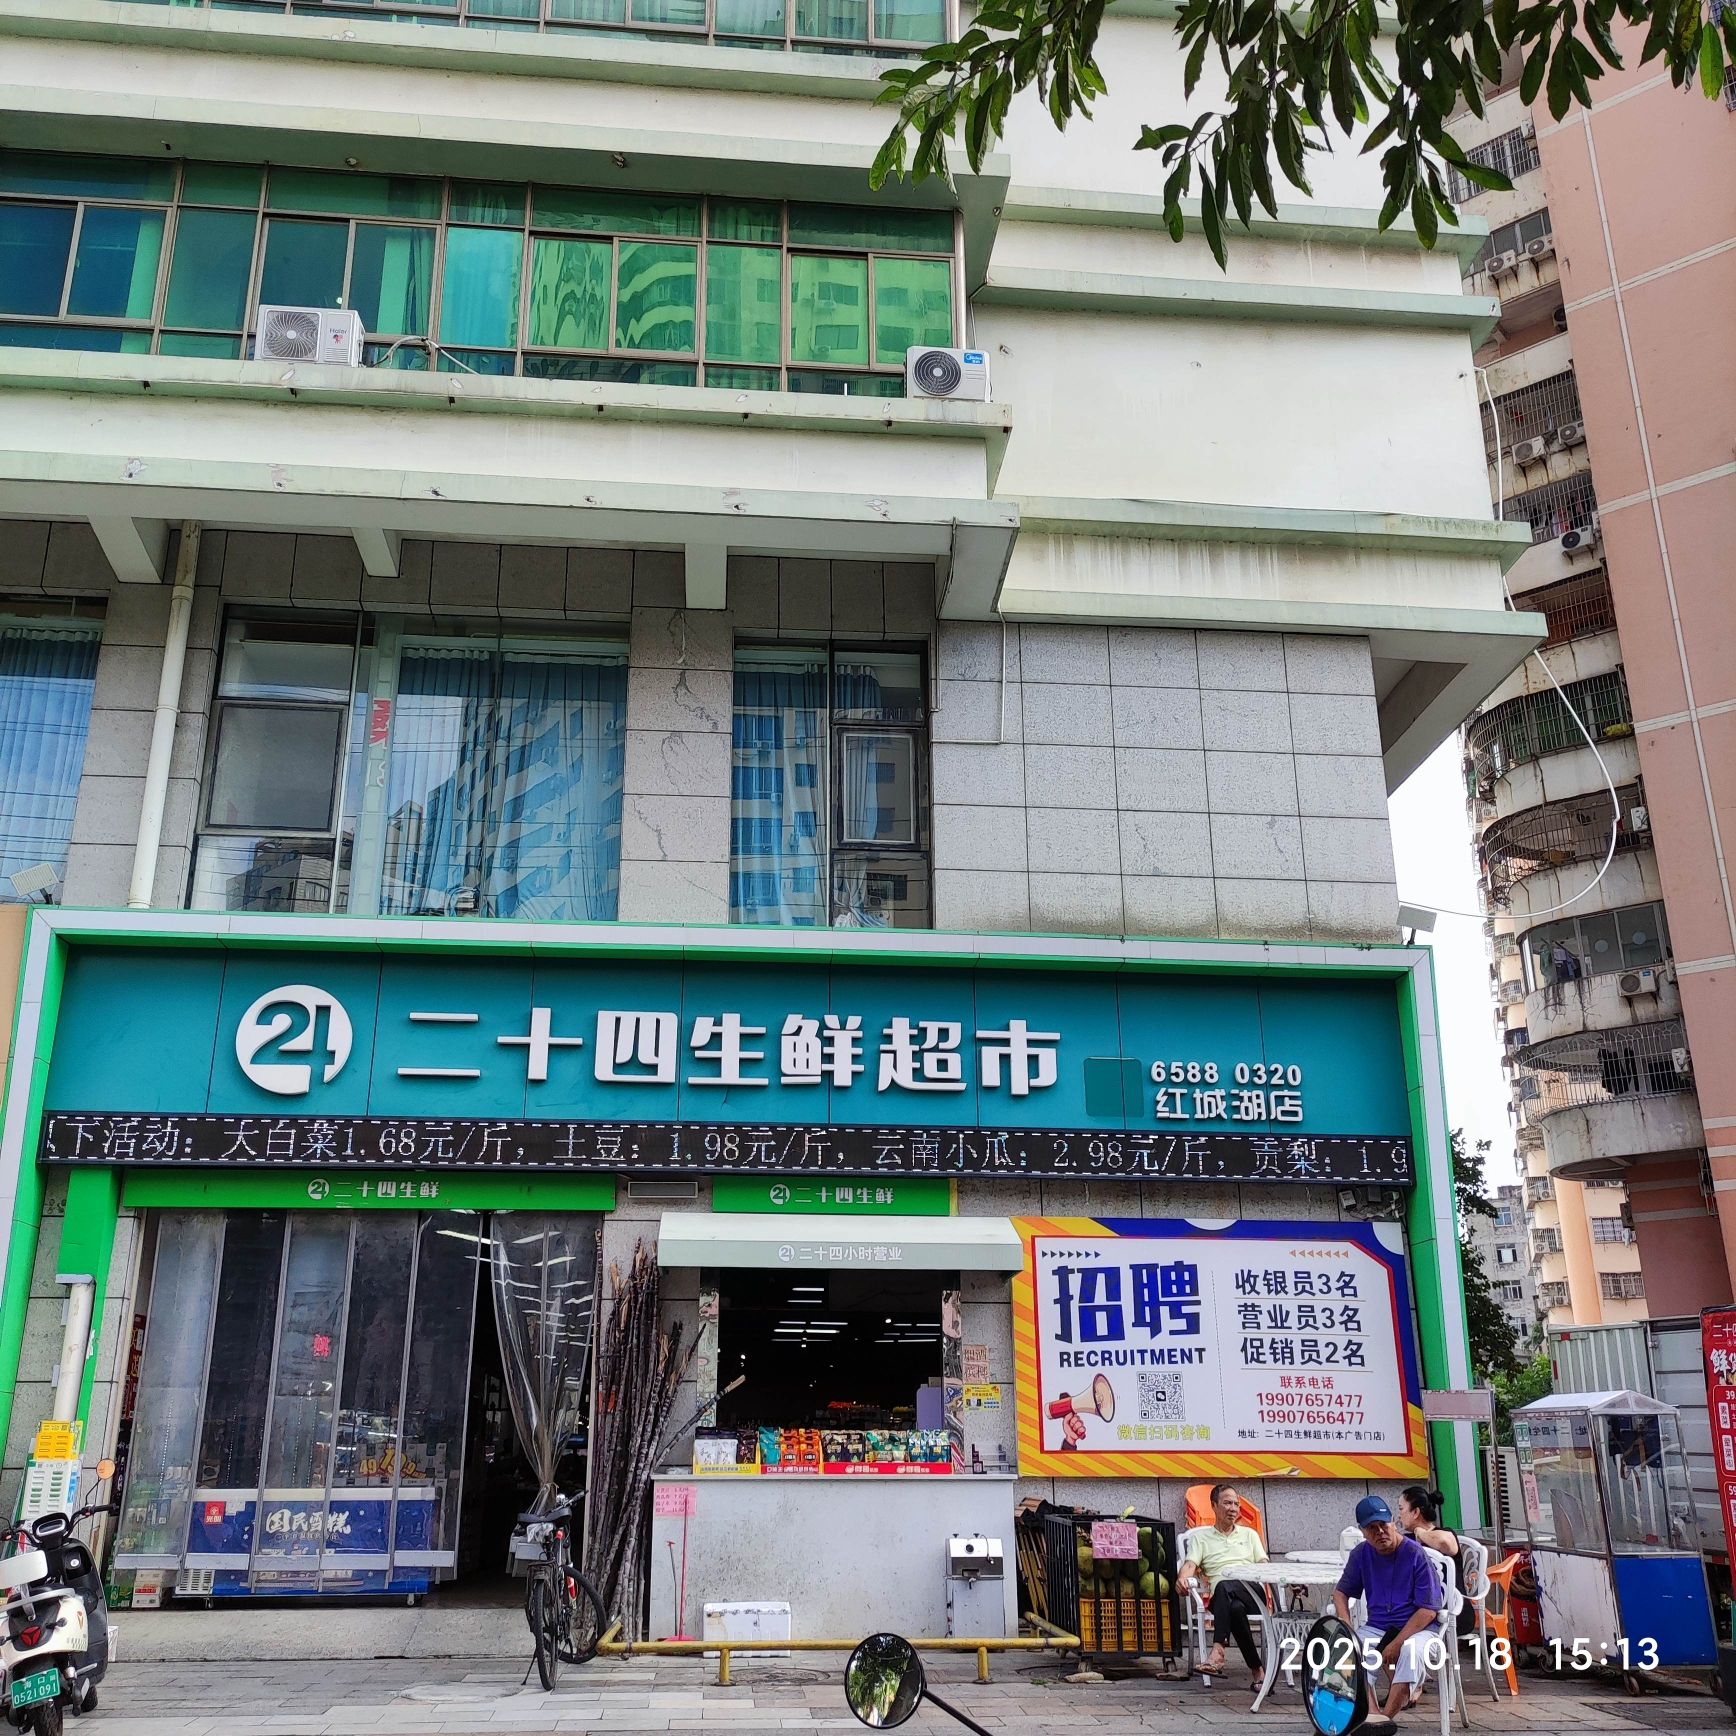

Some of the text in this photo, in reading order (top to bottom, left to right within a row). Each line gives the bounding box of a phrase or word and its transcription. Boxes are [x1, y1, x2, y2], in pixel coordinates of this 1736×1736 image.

[397, 1005, 1062, 1096] 二十四生鲜超市
[1150, 1060, 1303, 1087] 6588 0320
[1154, 1086, 1304, 1123] 红城湖店
[333, 1180, 440, 1199] 二十四生鲜
[794, 1185, 895, 1205] 二十四生鲜
[799, 1245, 903, 1262] 二十四小时营业
[1234, 1268, 1359, 1299] 收银员3名
[1051, 1260, 1202, 1345] 招聘
[1237, 1302, 1362, 1333] 营业员3名
[1058, 1347, 1207, 1369] RECRUITMENT
[1240, 1336, 1366, 1368] 促销员2名
[1280, 1375, 1335, 1390] 联系电话
[1256, 1392, 1363, 1408] 19907657477
[1257, 1409, 1365, 1426] 19907656477
[1116, 1424, 1212, 1441] 微信扫码咨询
[265, 1508, 352, 1535] 国民雪糕
[14, 1681, 57, 1705] 0521091
